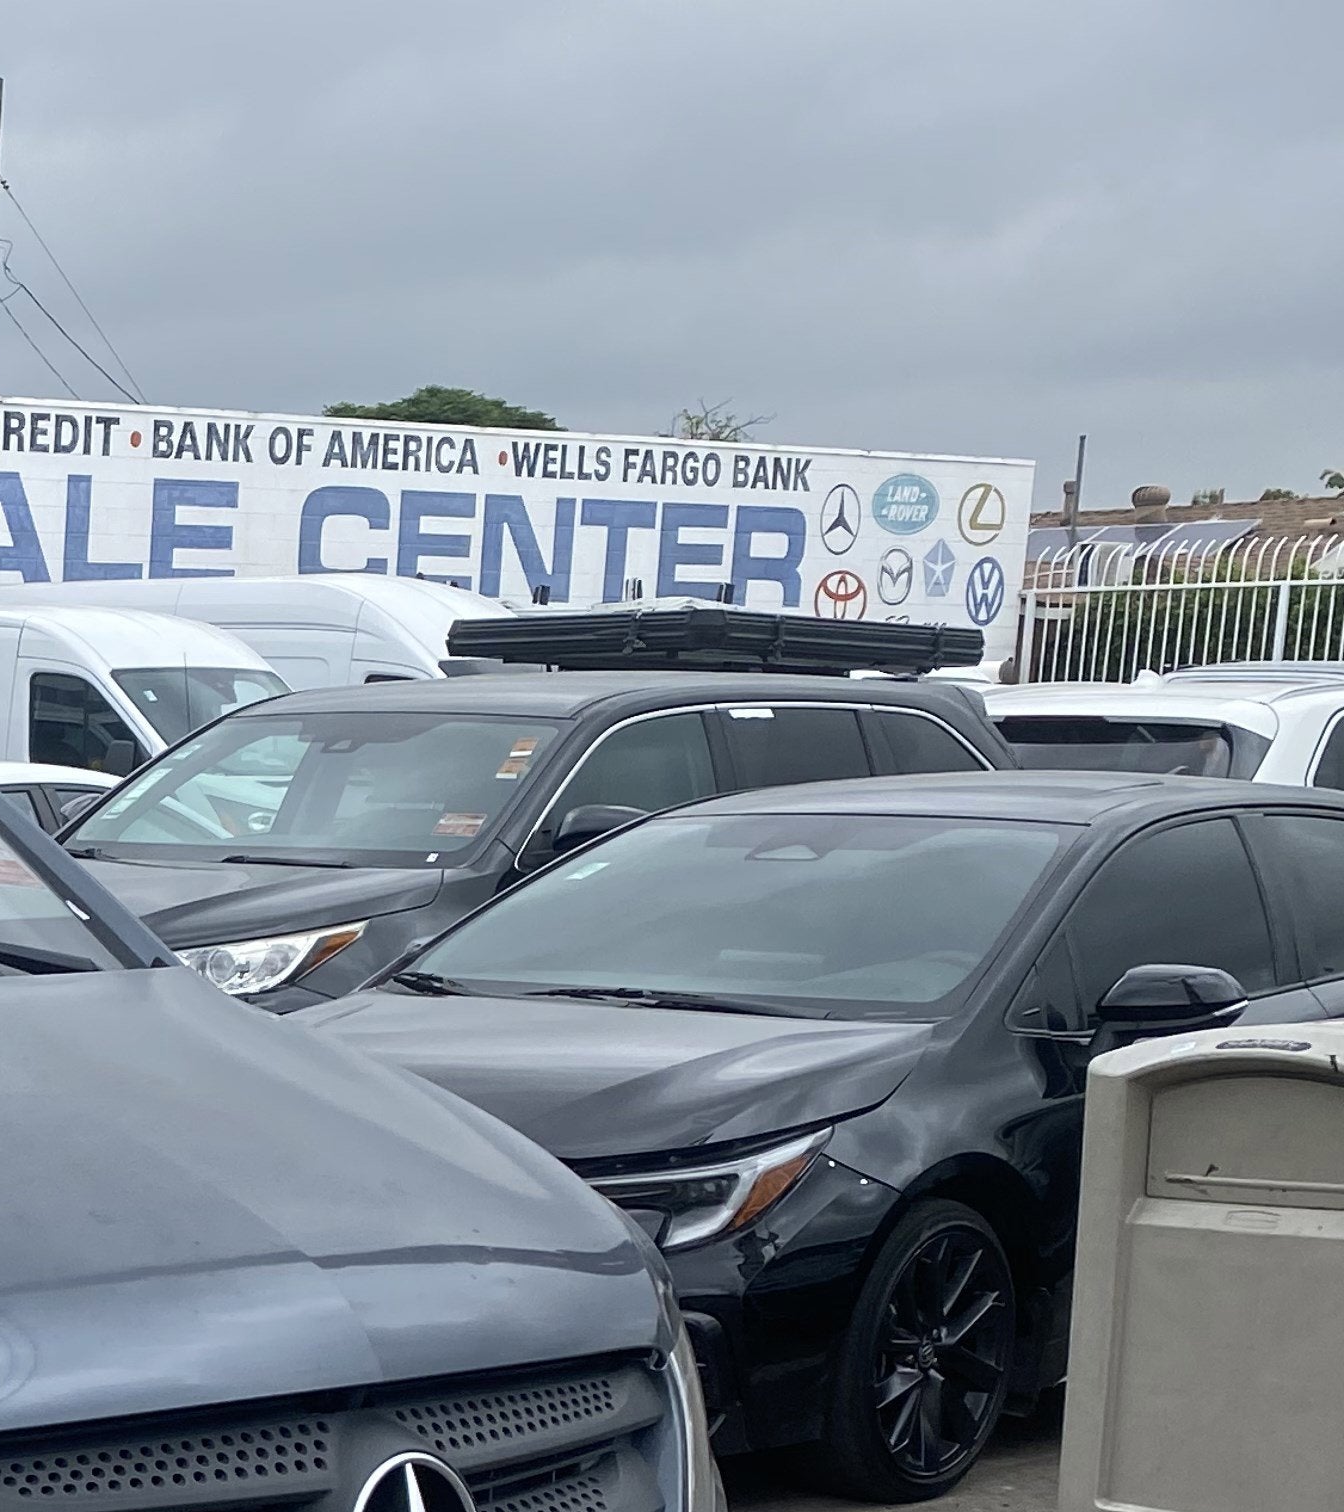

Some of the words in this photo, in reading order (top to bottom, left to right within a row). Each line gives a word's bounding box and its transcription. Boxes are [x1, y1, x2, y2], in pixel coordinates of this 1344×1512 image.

[151, 419, 255, 464] BANK
[269, 426, 314, 467] OF
[322, 430, 480, 476] AMERICA
[511, 441, 611, 483] WELLS
[623, 448, 721, 487] FARGO
[731, 454, 812, 492] BANK
[297, 485, 807, 608] CENTER
